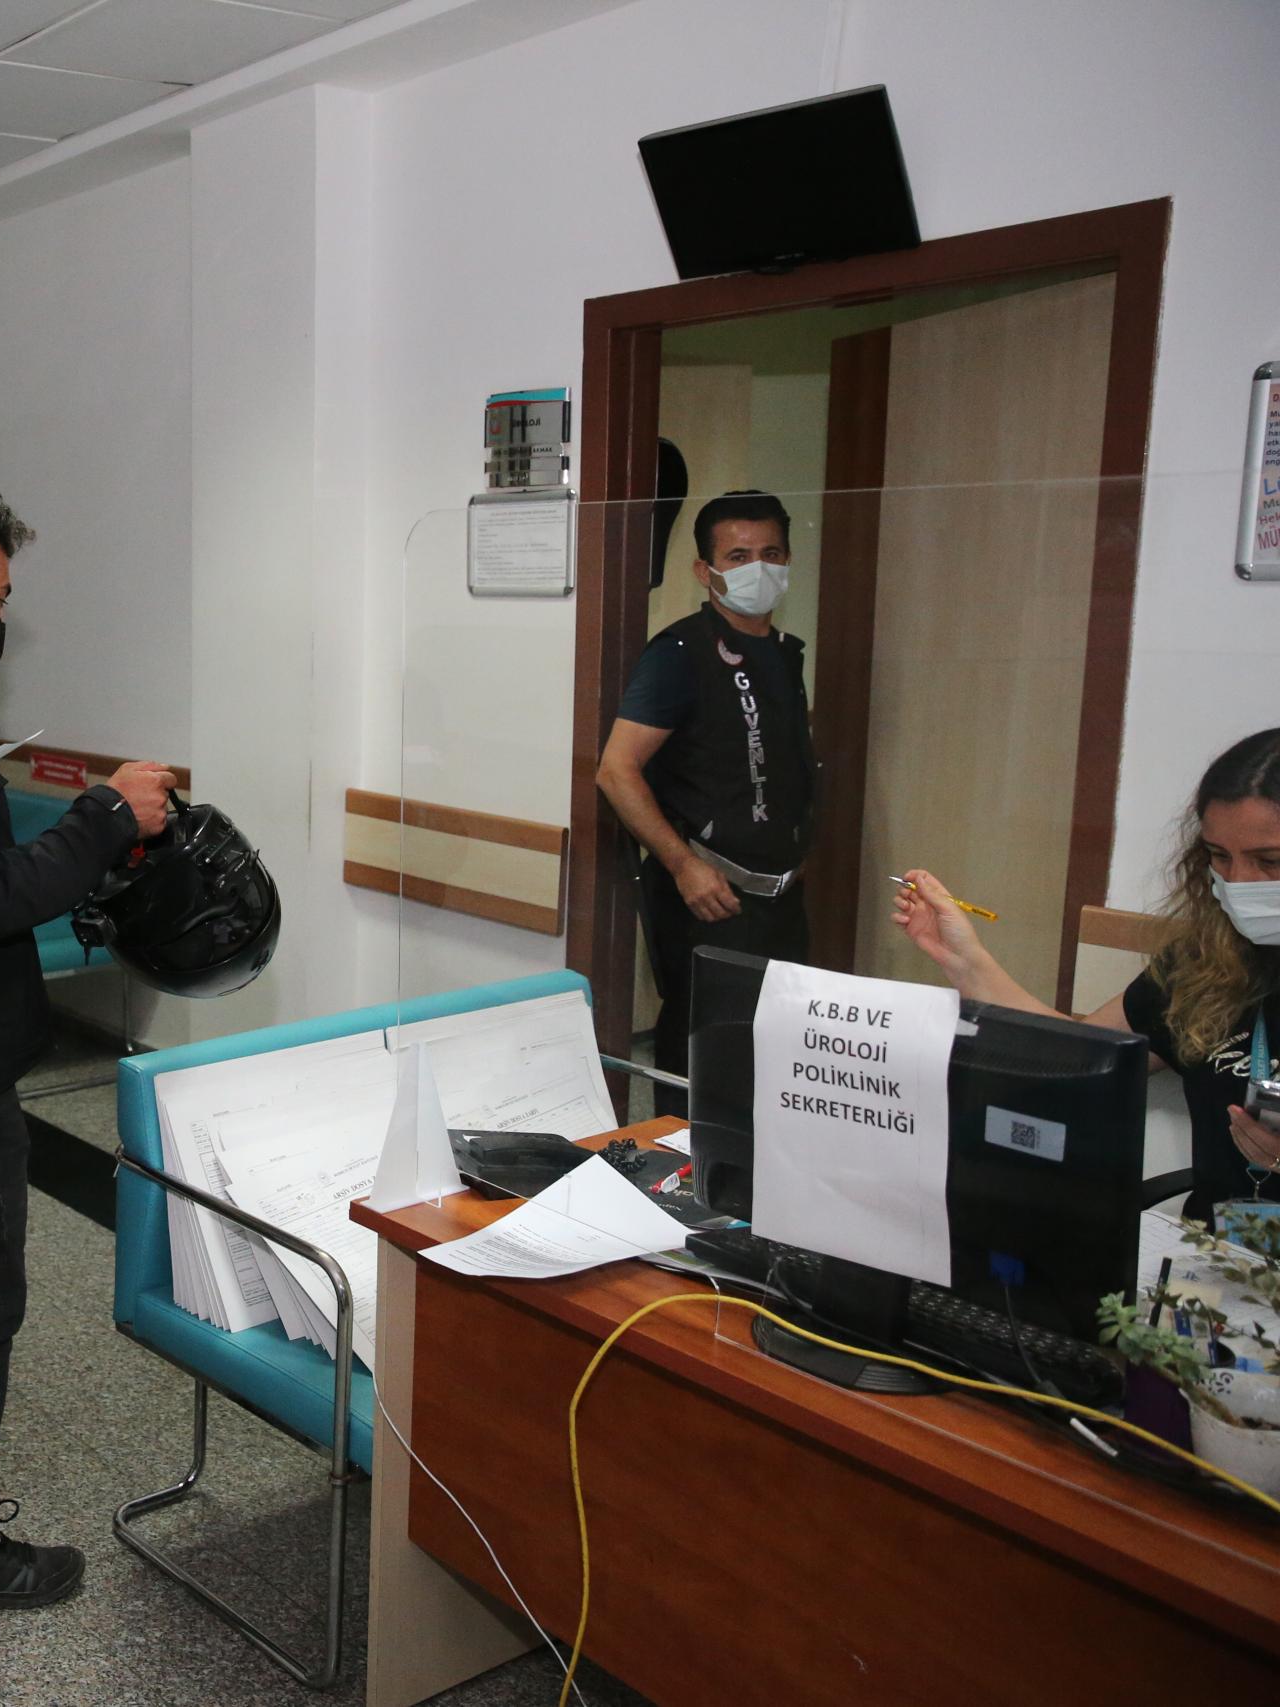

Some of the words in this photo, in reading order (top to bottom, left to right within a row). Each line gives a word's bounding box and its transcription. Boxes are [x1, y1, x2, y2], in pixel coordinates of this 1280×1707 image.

[807, 999, 859, 1023] K.B.B
[866, 1008, 893, 1029] VE
[804, 1027, 888, 1064] ÜROLOJİ
[793, 1062, 901, 1099] POLİKLİNİK
[780, 1091, 915, 1135] SEKRETERLİĞİ
